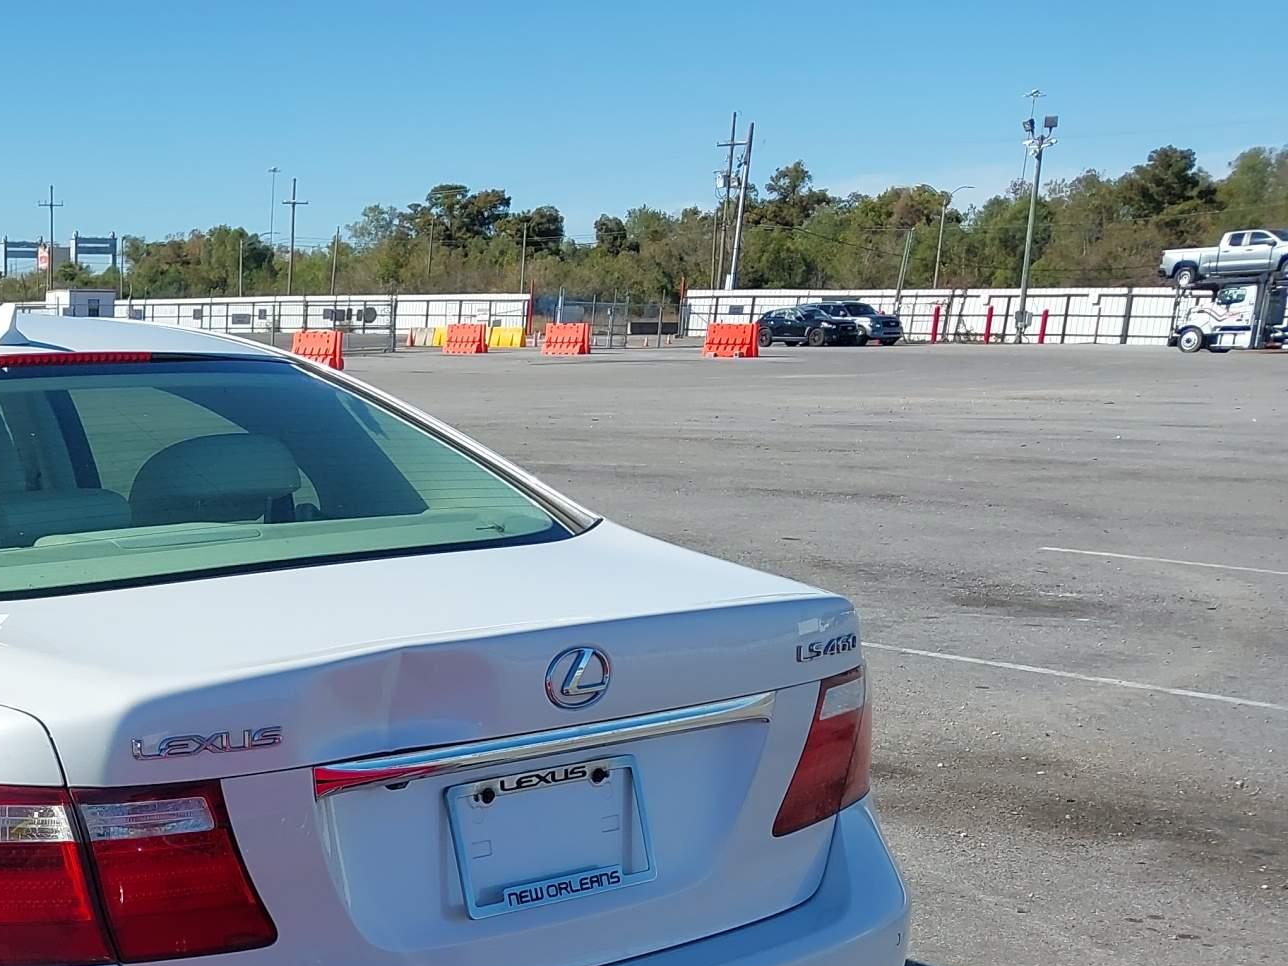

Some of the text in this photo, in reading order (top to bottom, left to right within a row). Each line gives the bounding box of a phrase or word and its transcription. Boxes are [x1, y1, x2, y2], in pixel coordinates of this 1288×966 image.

[132, 726, 282, 760] LEXUS
[500, 765, 587, 792] LEXUS
[508, 870, 620, 906] NEW ORLEANS
